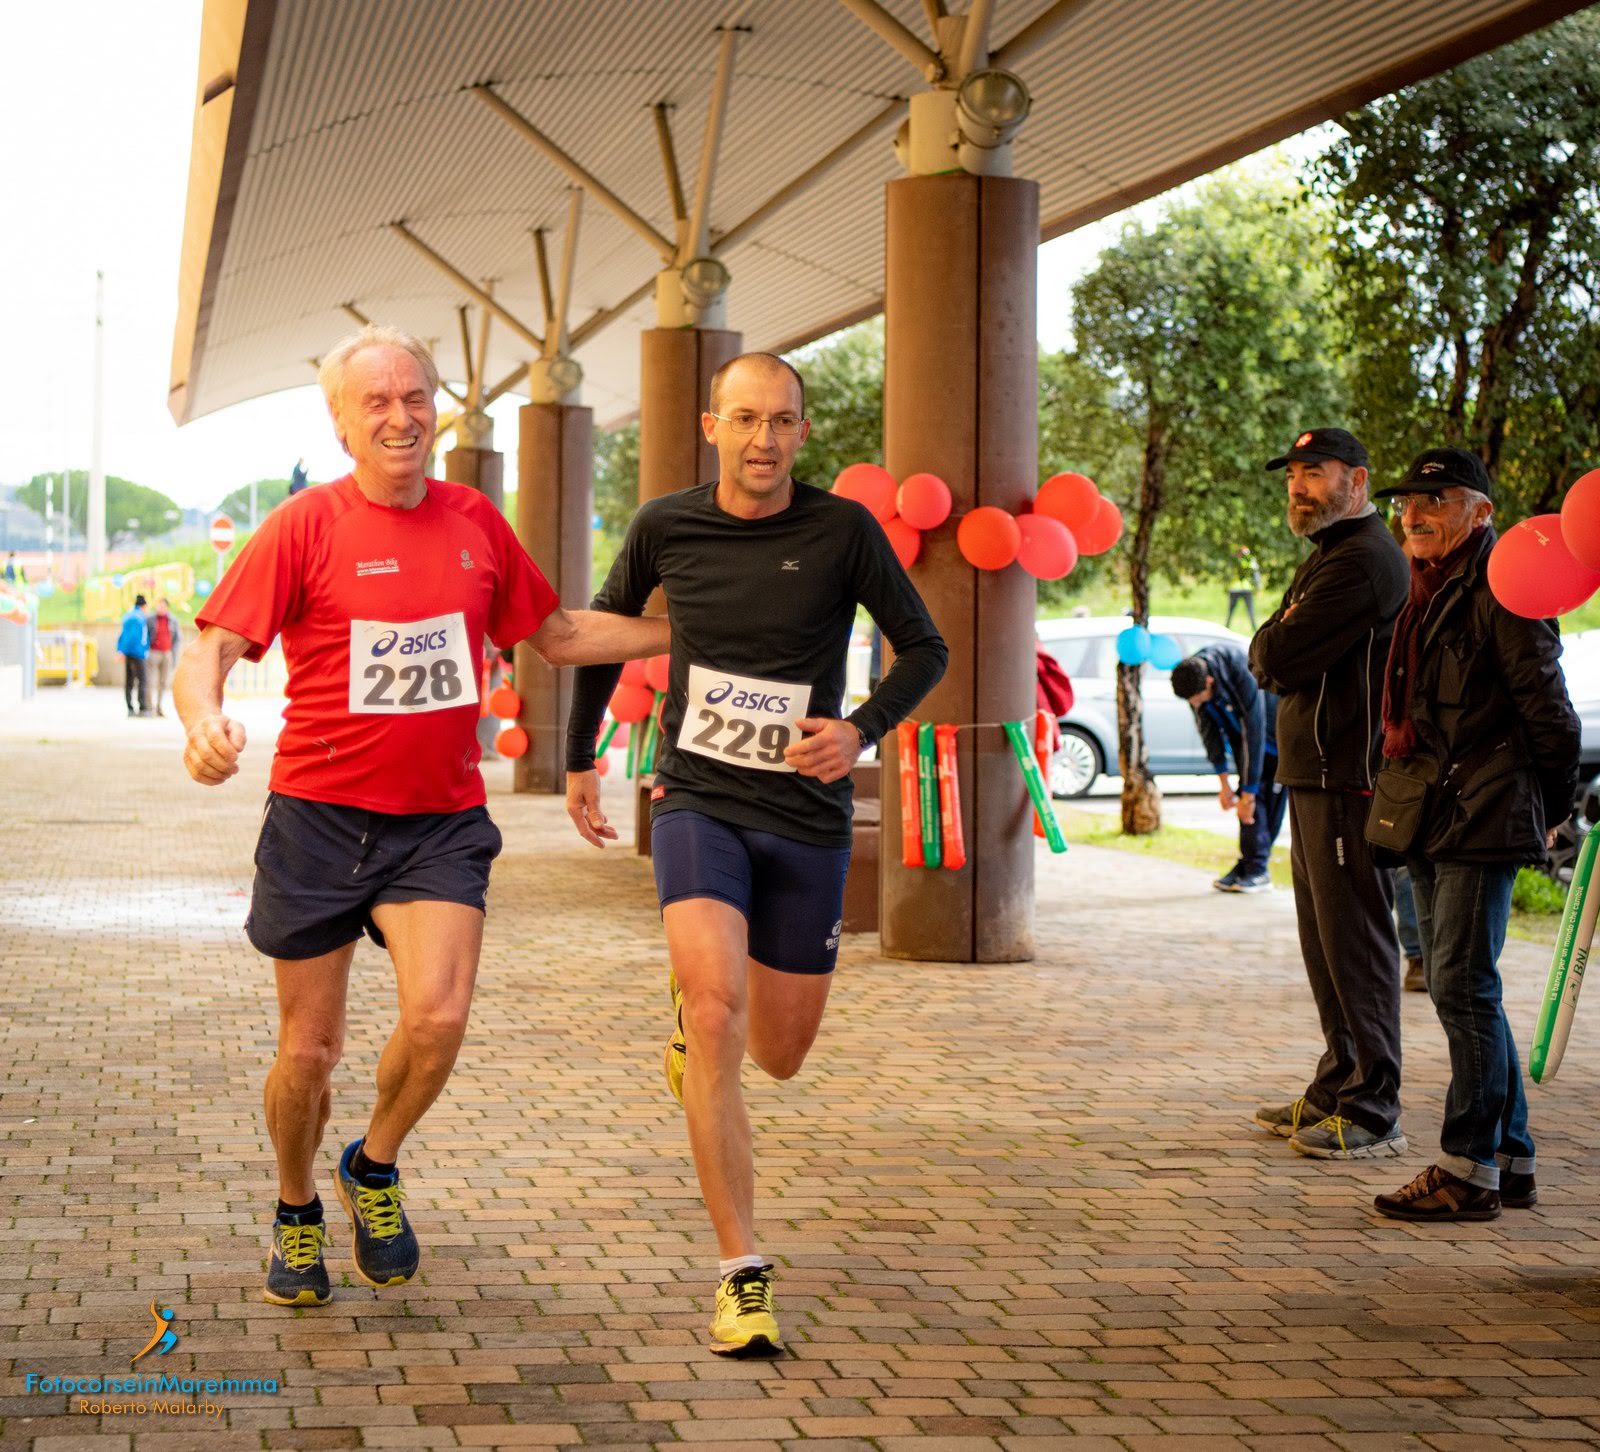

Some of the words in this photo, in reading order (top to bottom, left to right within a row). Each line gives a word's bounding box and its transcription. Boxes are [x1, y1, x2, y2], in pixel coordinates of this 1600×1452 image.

[400, 629, 448, 656] asics
[363, 659, 463, 706] 228
[731, 690, 790, 714] asics
[692, 708, 791, 764] 229
[1573, 886, 1584, 910] cambia
[1569, 910, 1578, 923] che
[1564, 924, 1575, 948] mondo
[1558, 957, 1566, 970] per
[1561, 948, 1569, 957] un
[1552, 971, 1563, 991] banca
[1550, 992, 1558, 1001] La
